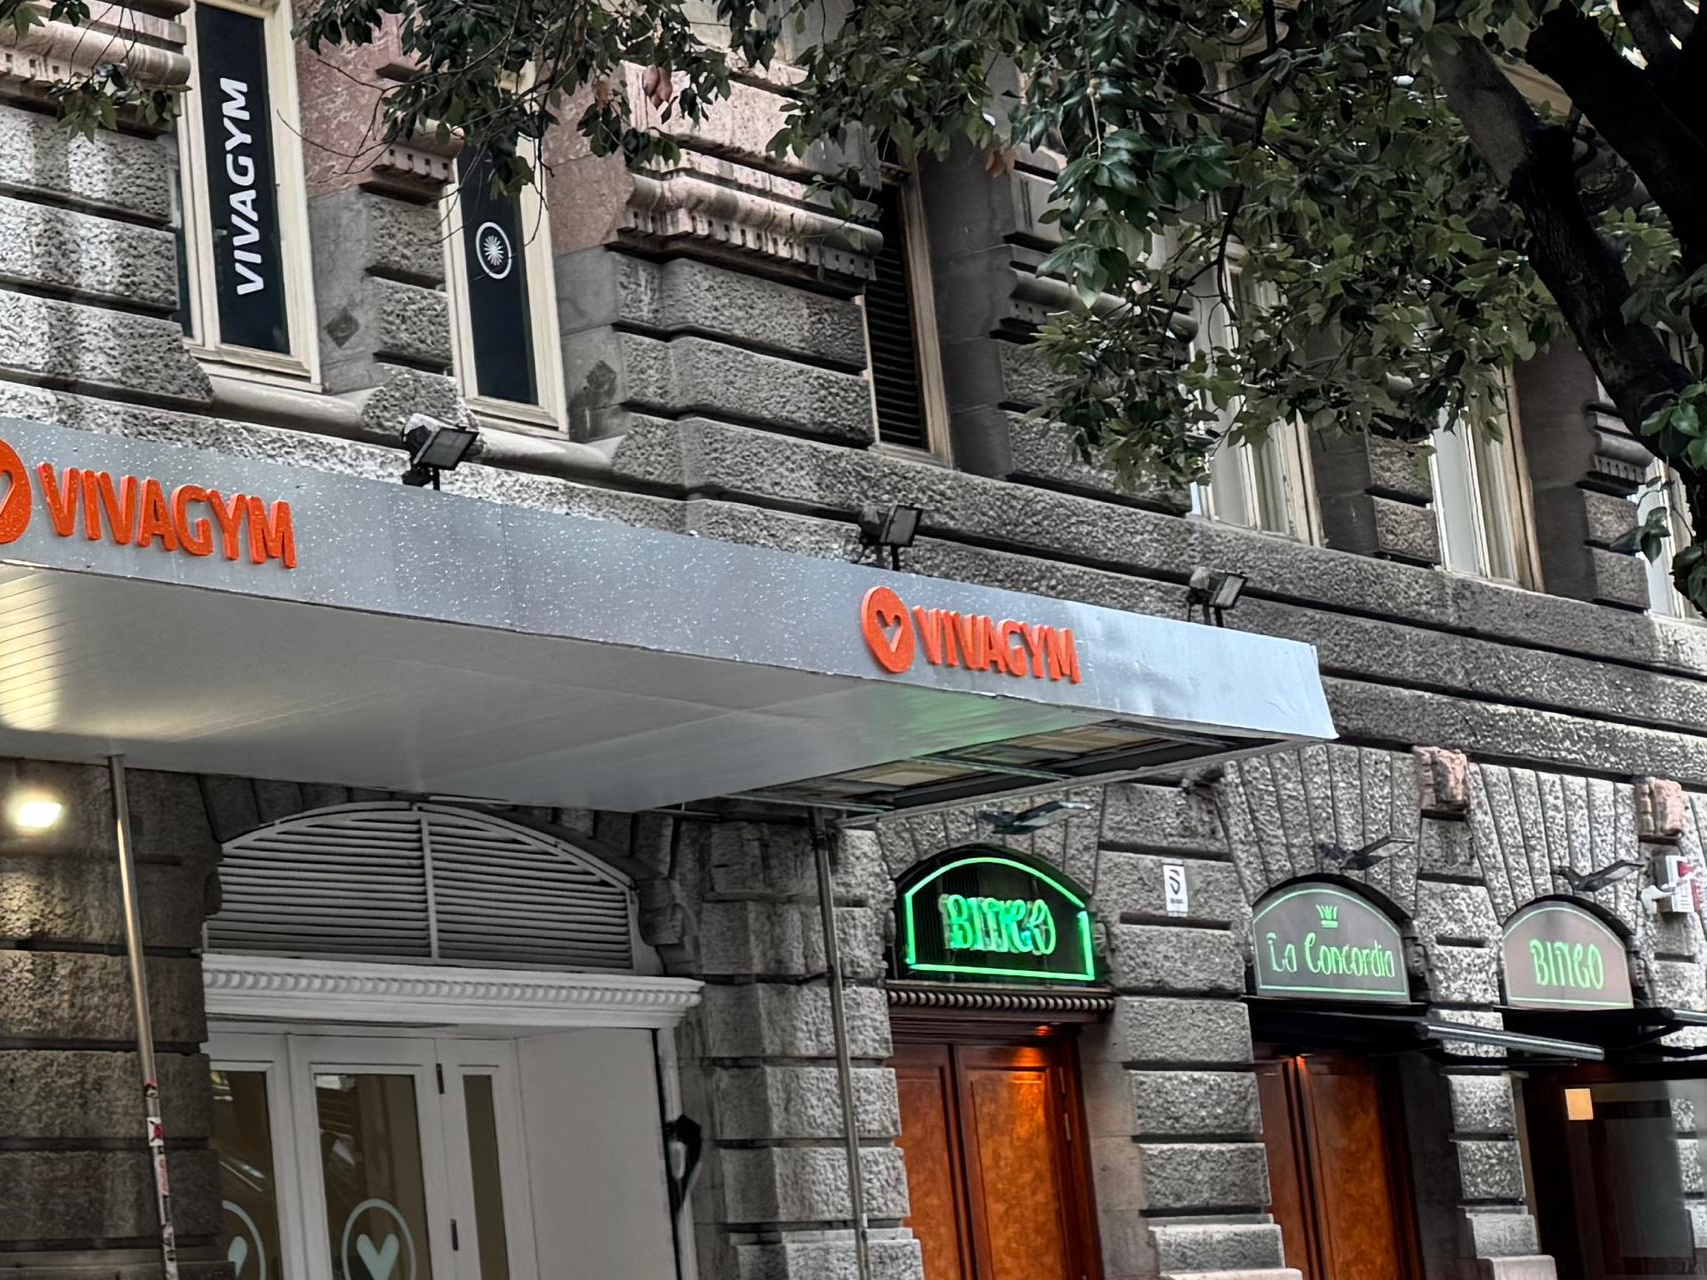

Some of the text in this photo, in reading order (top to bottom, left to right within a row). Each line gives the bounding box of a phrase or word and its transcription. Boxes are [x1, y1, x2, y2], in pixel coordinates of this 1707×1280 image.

[219, 77, 264, 295] VIVAGYM
[35, 463, 297, 569] VIVAGYM
[912, 605, 1082, 684] VIVAGYM
[1266, 931, 1396, 978] La Concordia
[1529, 938, 1605, 991] BINGO
